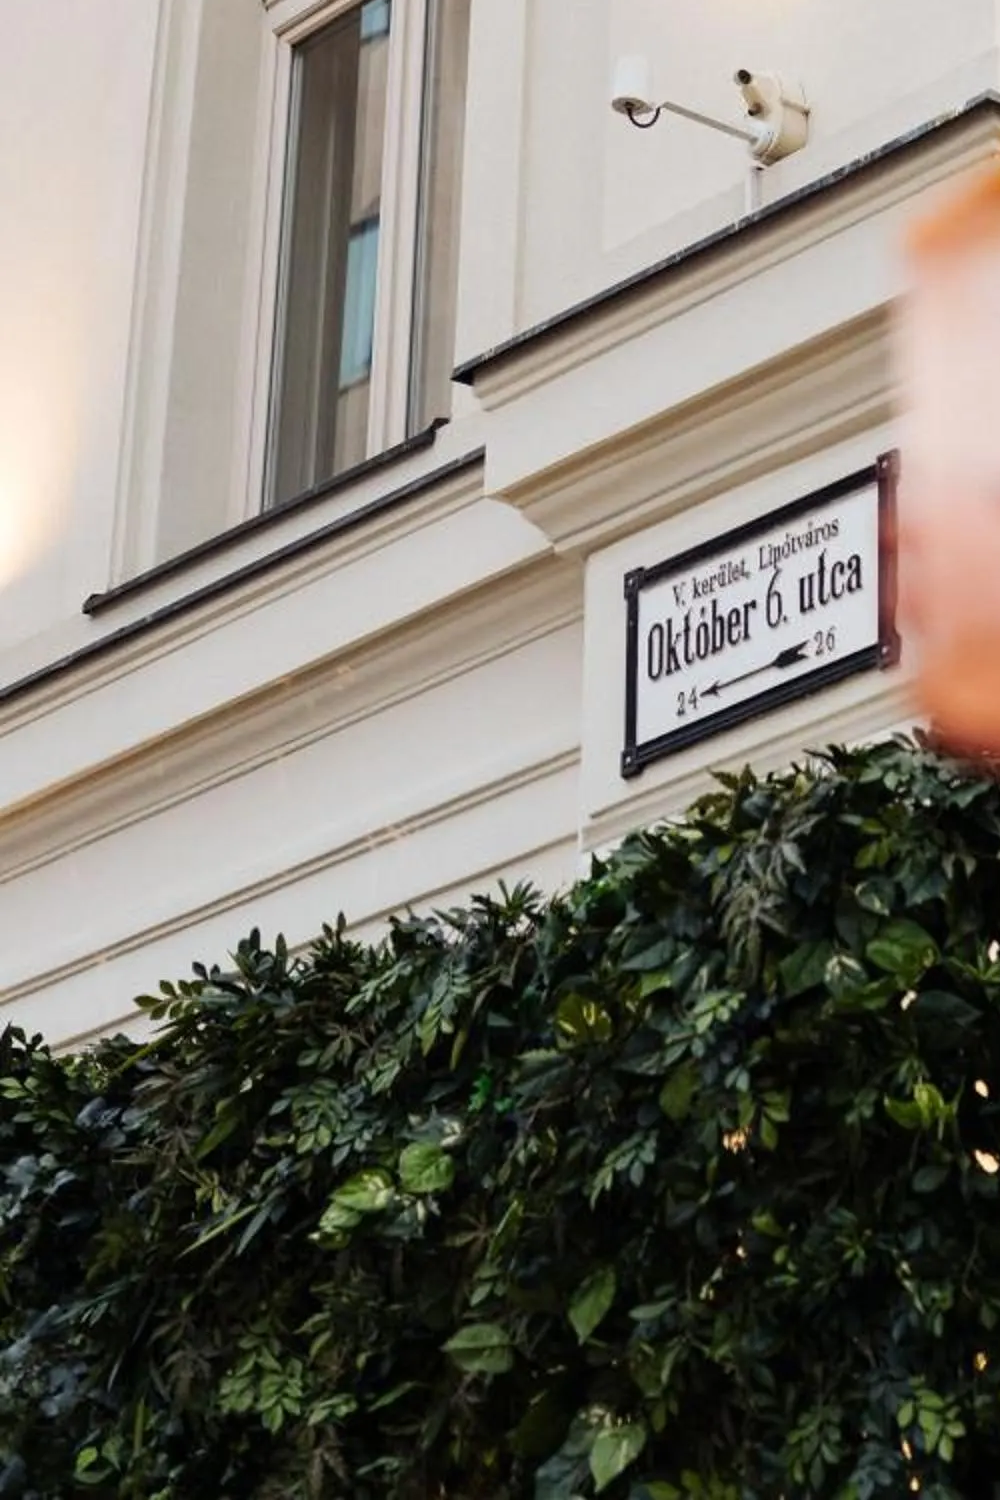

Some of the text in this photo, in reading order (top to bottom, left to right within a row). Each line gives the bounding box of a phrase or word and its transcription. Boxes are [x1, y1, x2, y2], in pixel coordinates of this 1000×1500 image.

[672, 583, 687, 607] V.
[758, 518, 840, 570] Lipótváros
[647, 549, 863, 681] Október 6. utca
[676, 626, 837, 716] 24 26
